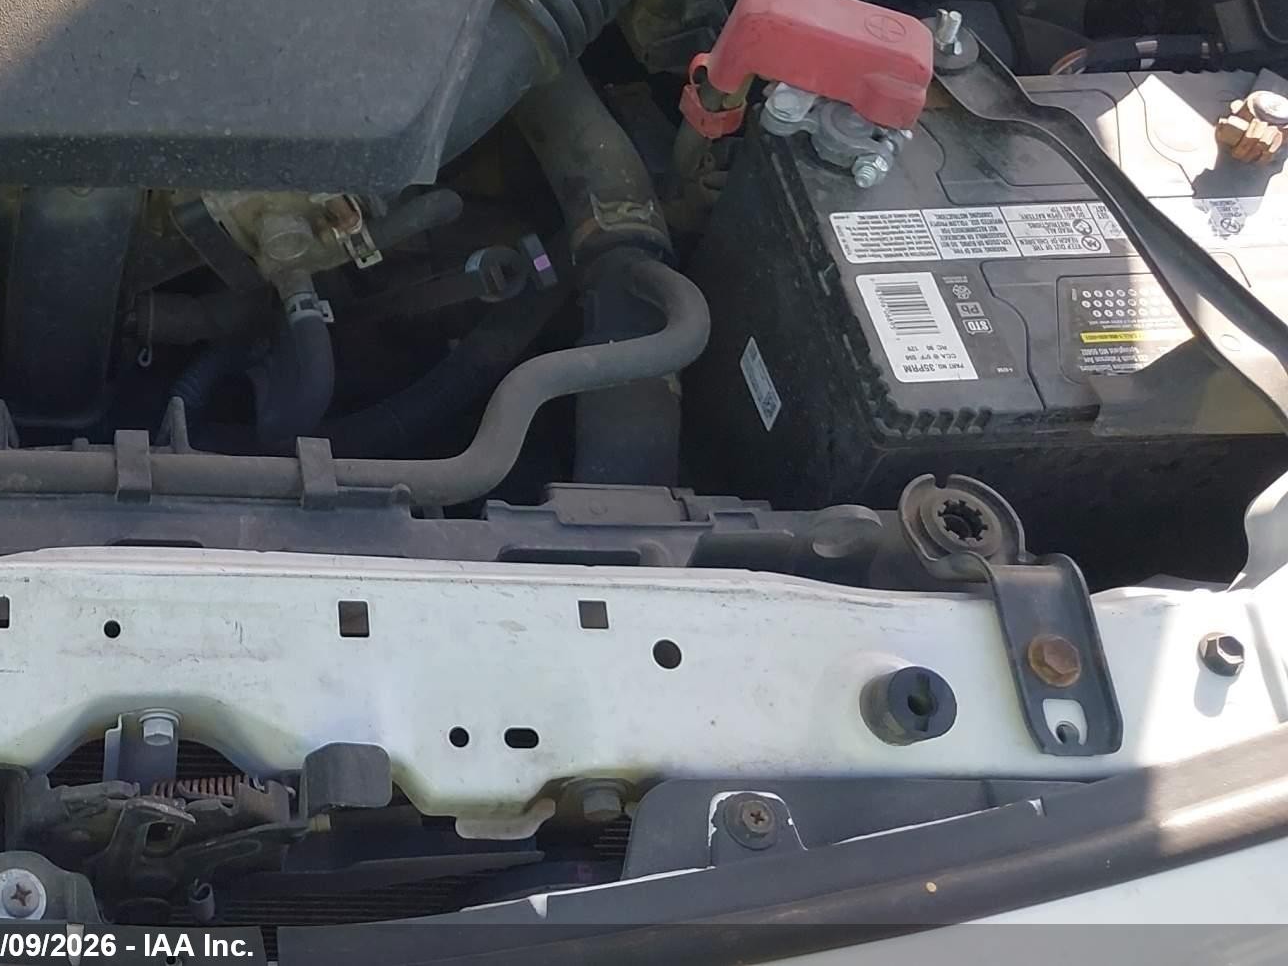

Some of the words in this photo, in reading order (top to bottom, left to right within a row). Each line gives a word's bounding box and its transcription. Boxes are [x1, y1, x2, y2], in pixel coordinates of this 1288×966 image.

[962, 304, 979, 314] Pb
[968, 321, 988, 330] STD
[902, 364, 936, 373] 35PRM
